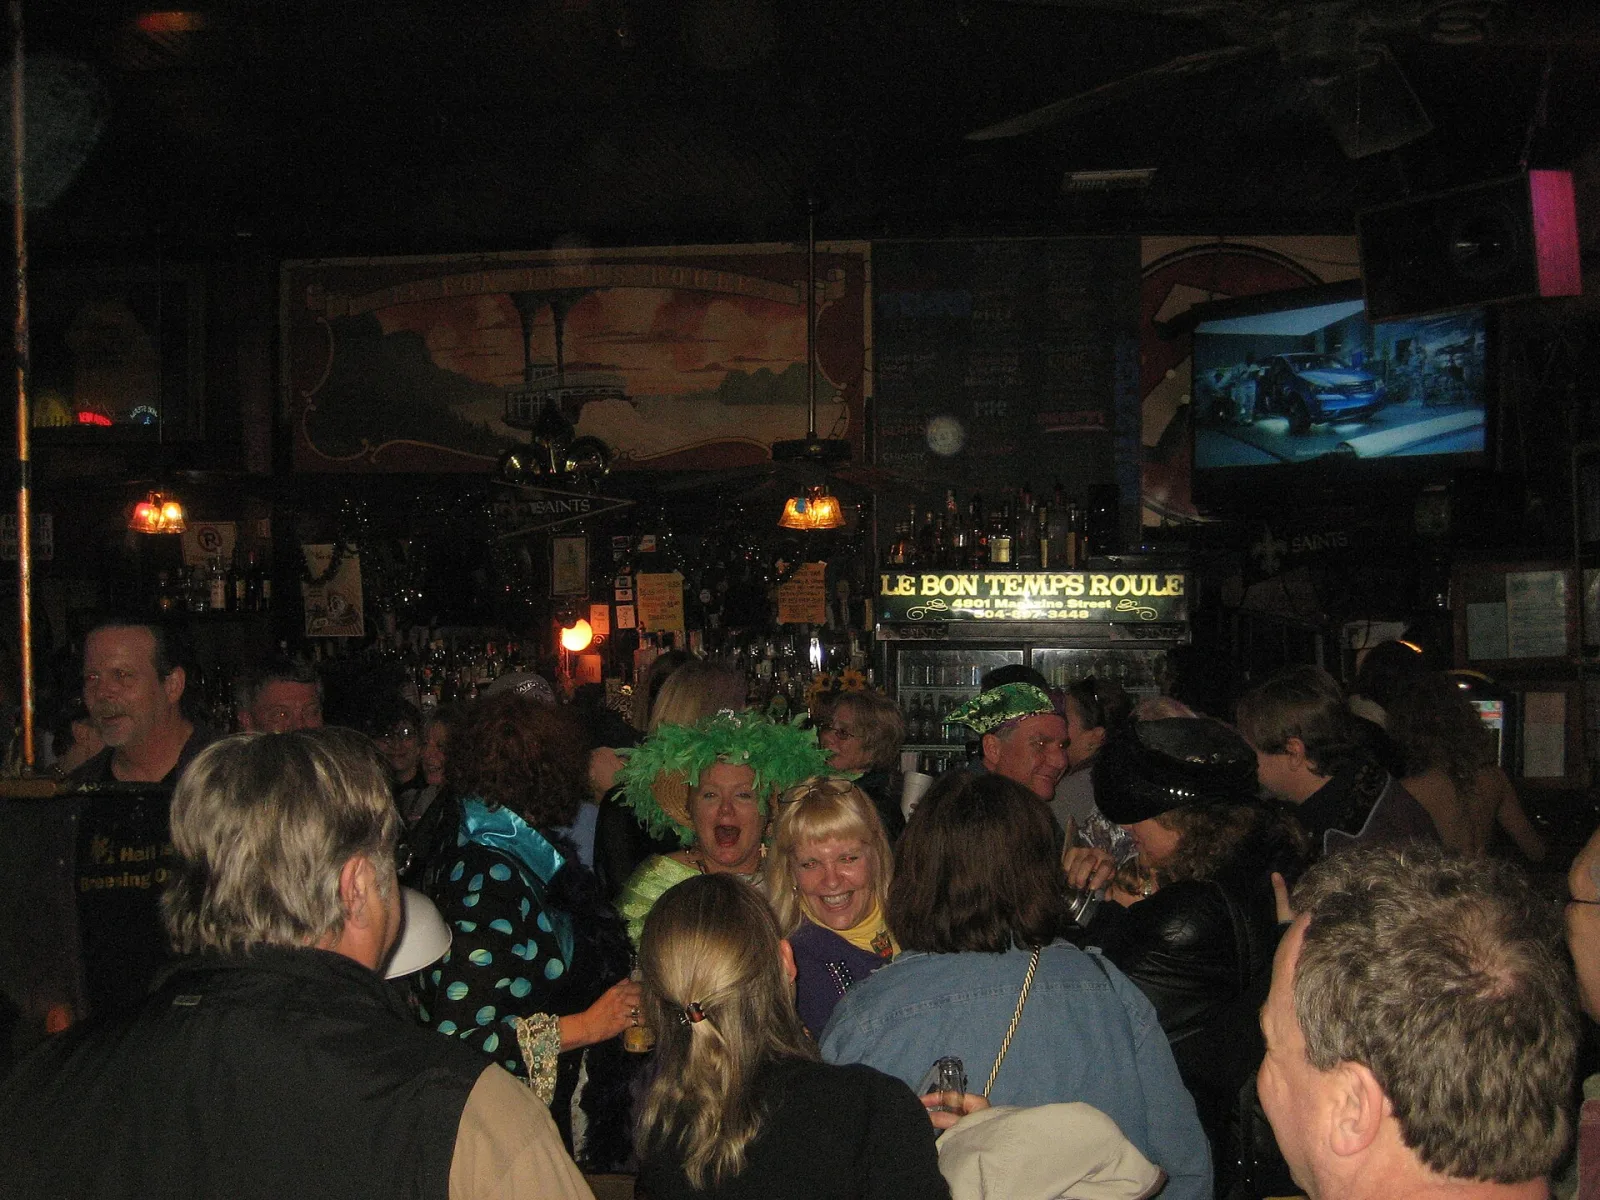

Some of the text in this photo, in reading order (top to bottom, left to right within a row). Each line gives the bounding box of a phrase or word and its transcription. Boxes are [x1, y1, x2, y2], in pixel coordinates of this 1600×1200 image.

[536, 498, 591, 514] SAINTS
[1292, 530, 1348, 553] SAINTS
[880, 574, 1185, 596] LE BON TEMPS ROULE
[1066, 598, 1112, 609] Street
